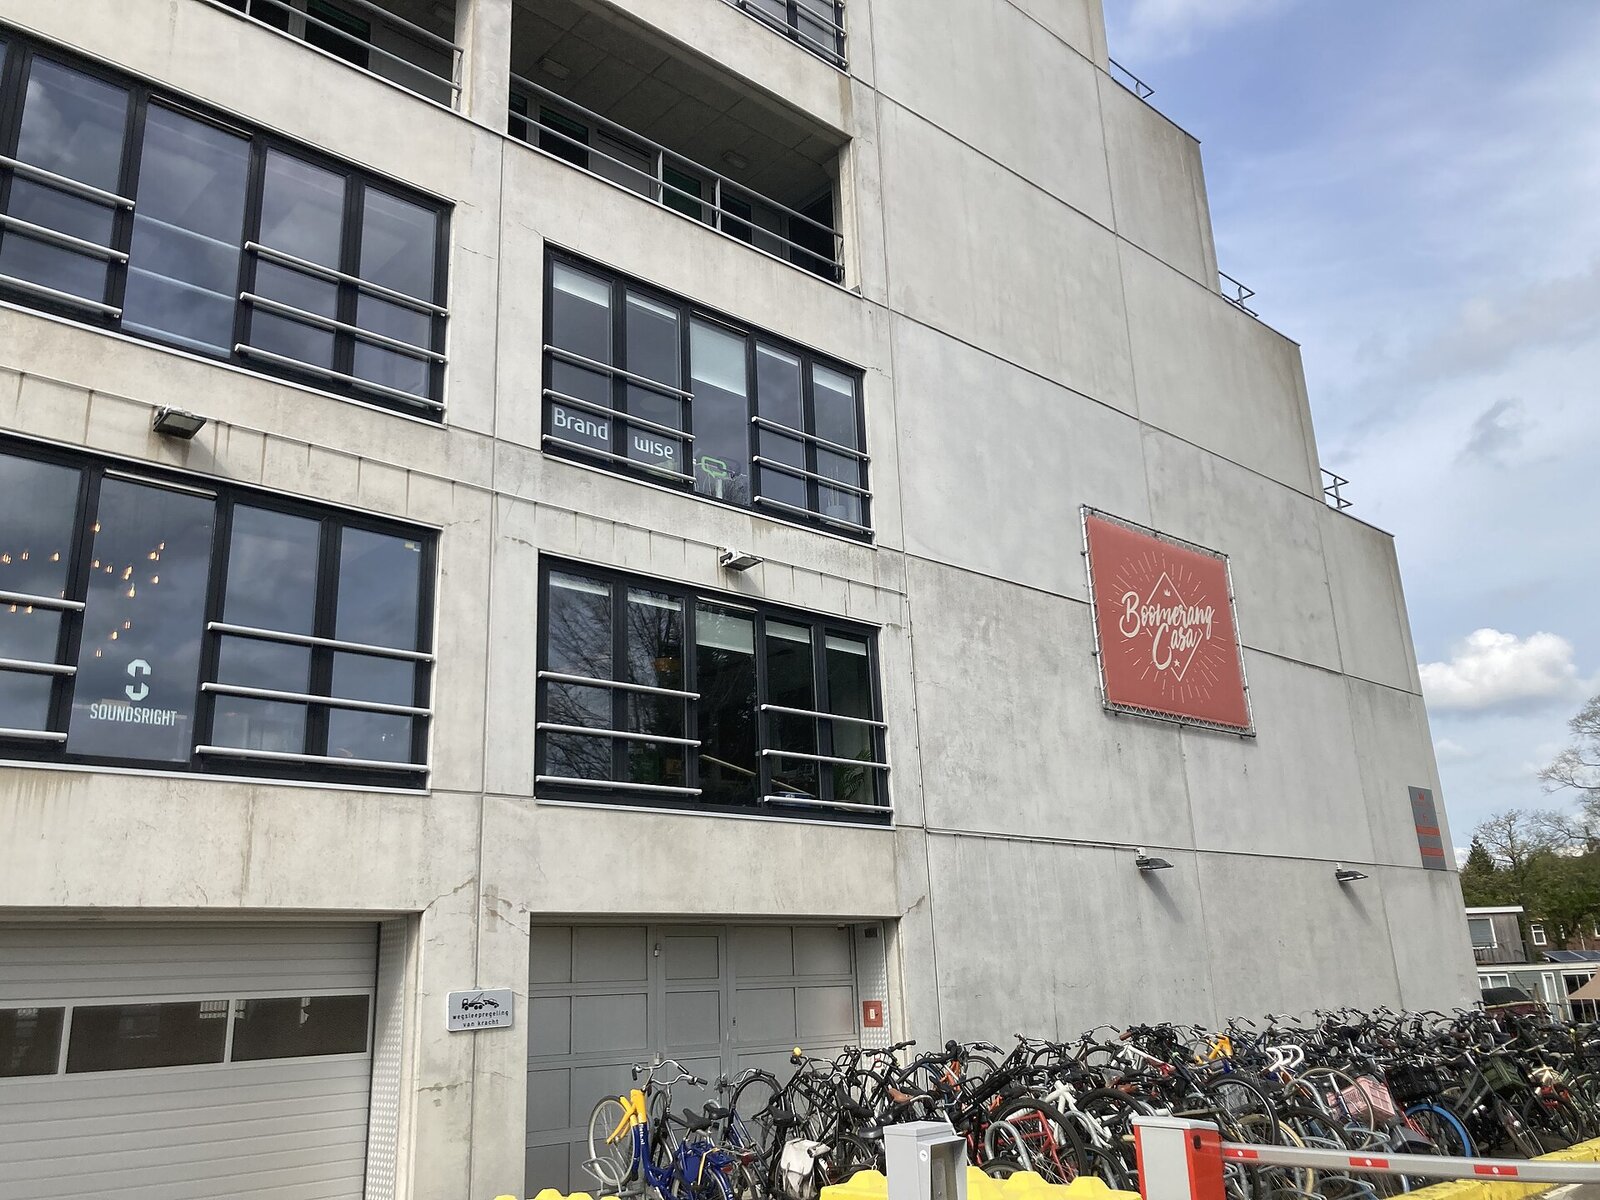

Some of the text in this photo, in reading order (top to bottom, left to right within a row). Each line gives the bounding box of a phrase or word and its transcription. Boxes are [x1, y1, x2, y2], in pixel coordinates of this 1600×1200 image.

[554, 407, 673, 459] Brand wise
[1119, 591, 1215, 640] Boomerang
[1153, 623, 1199, 670] Casa
[90, 703, 177, 726] SOUNDSRIGHT
[452, 1010, 509, 1020] wegsleepregeling
